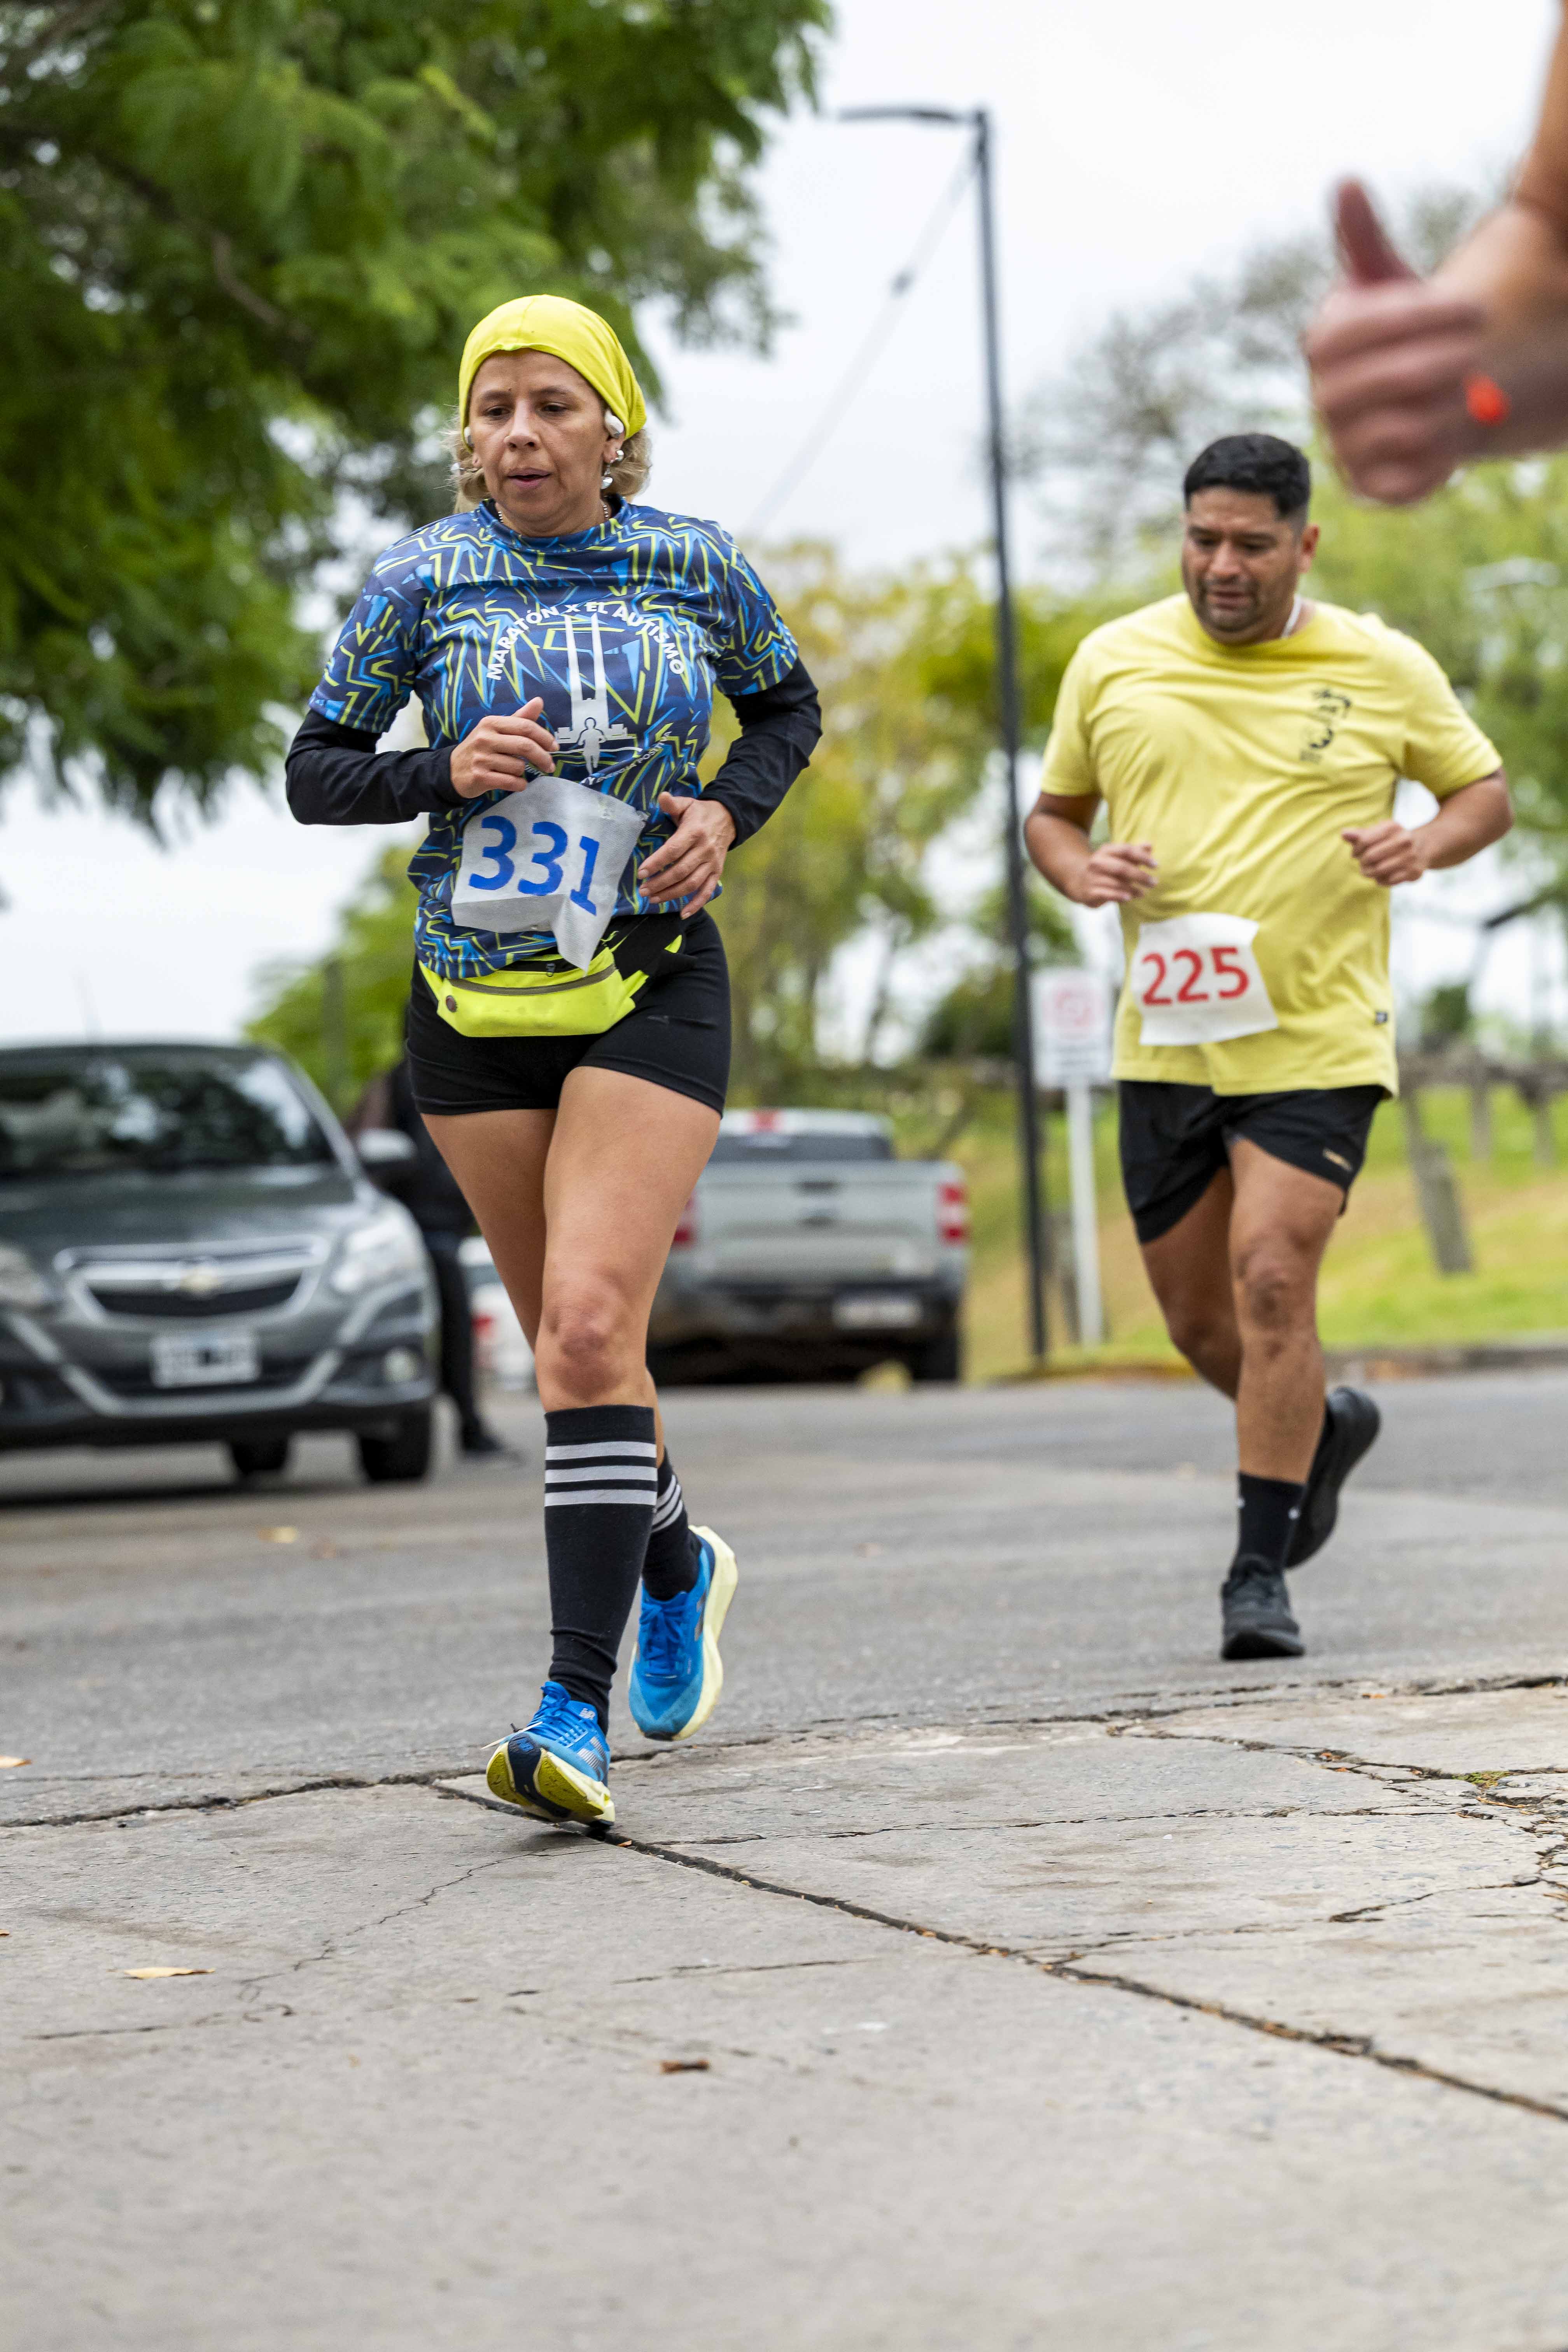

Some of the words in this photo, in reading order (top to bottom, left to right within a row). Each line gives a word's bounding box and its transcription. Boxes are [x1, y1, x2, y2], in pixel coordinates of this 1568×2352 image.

[486, 606, 560, 681] MARATÓN
[564, 604, 581, 613] X
[586, 601, 608, 614] EL
[611, 605, 685, 675] AUTISMO
[468, 815, 600, 916] 331
[1141, 946, 1250, 1006] 225
